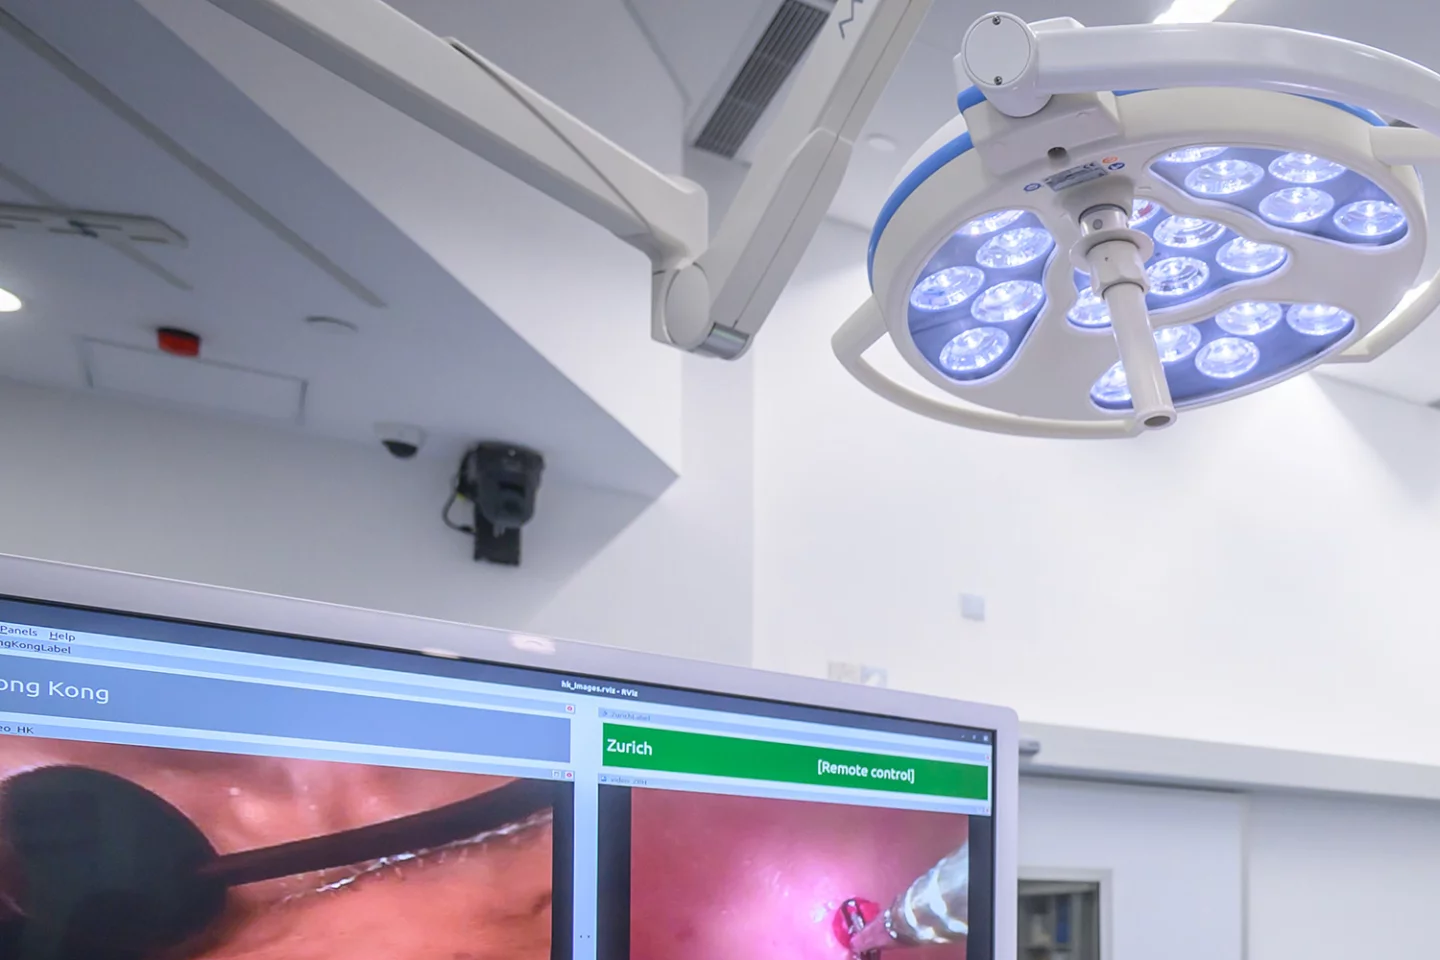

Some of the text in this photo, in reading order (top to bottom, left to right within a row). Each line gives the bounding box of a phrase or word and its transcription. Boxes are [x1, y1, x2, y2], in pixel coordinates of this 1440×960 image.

[0, 625, 76, 642] Panels Help
[48, 680, 109, 704] Kong
[606, 738, 915, 784] Zurich [Remote control]
